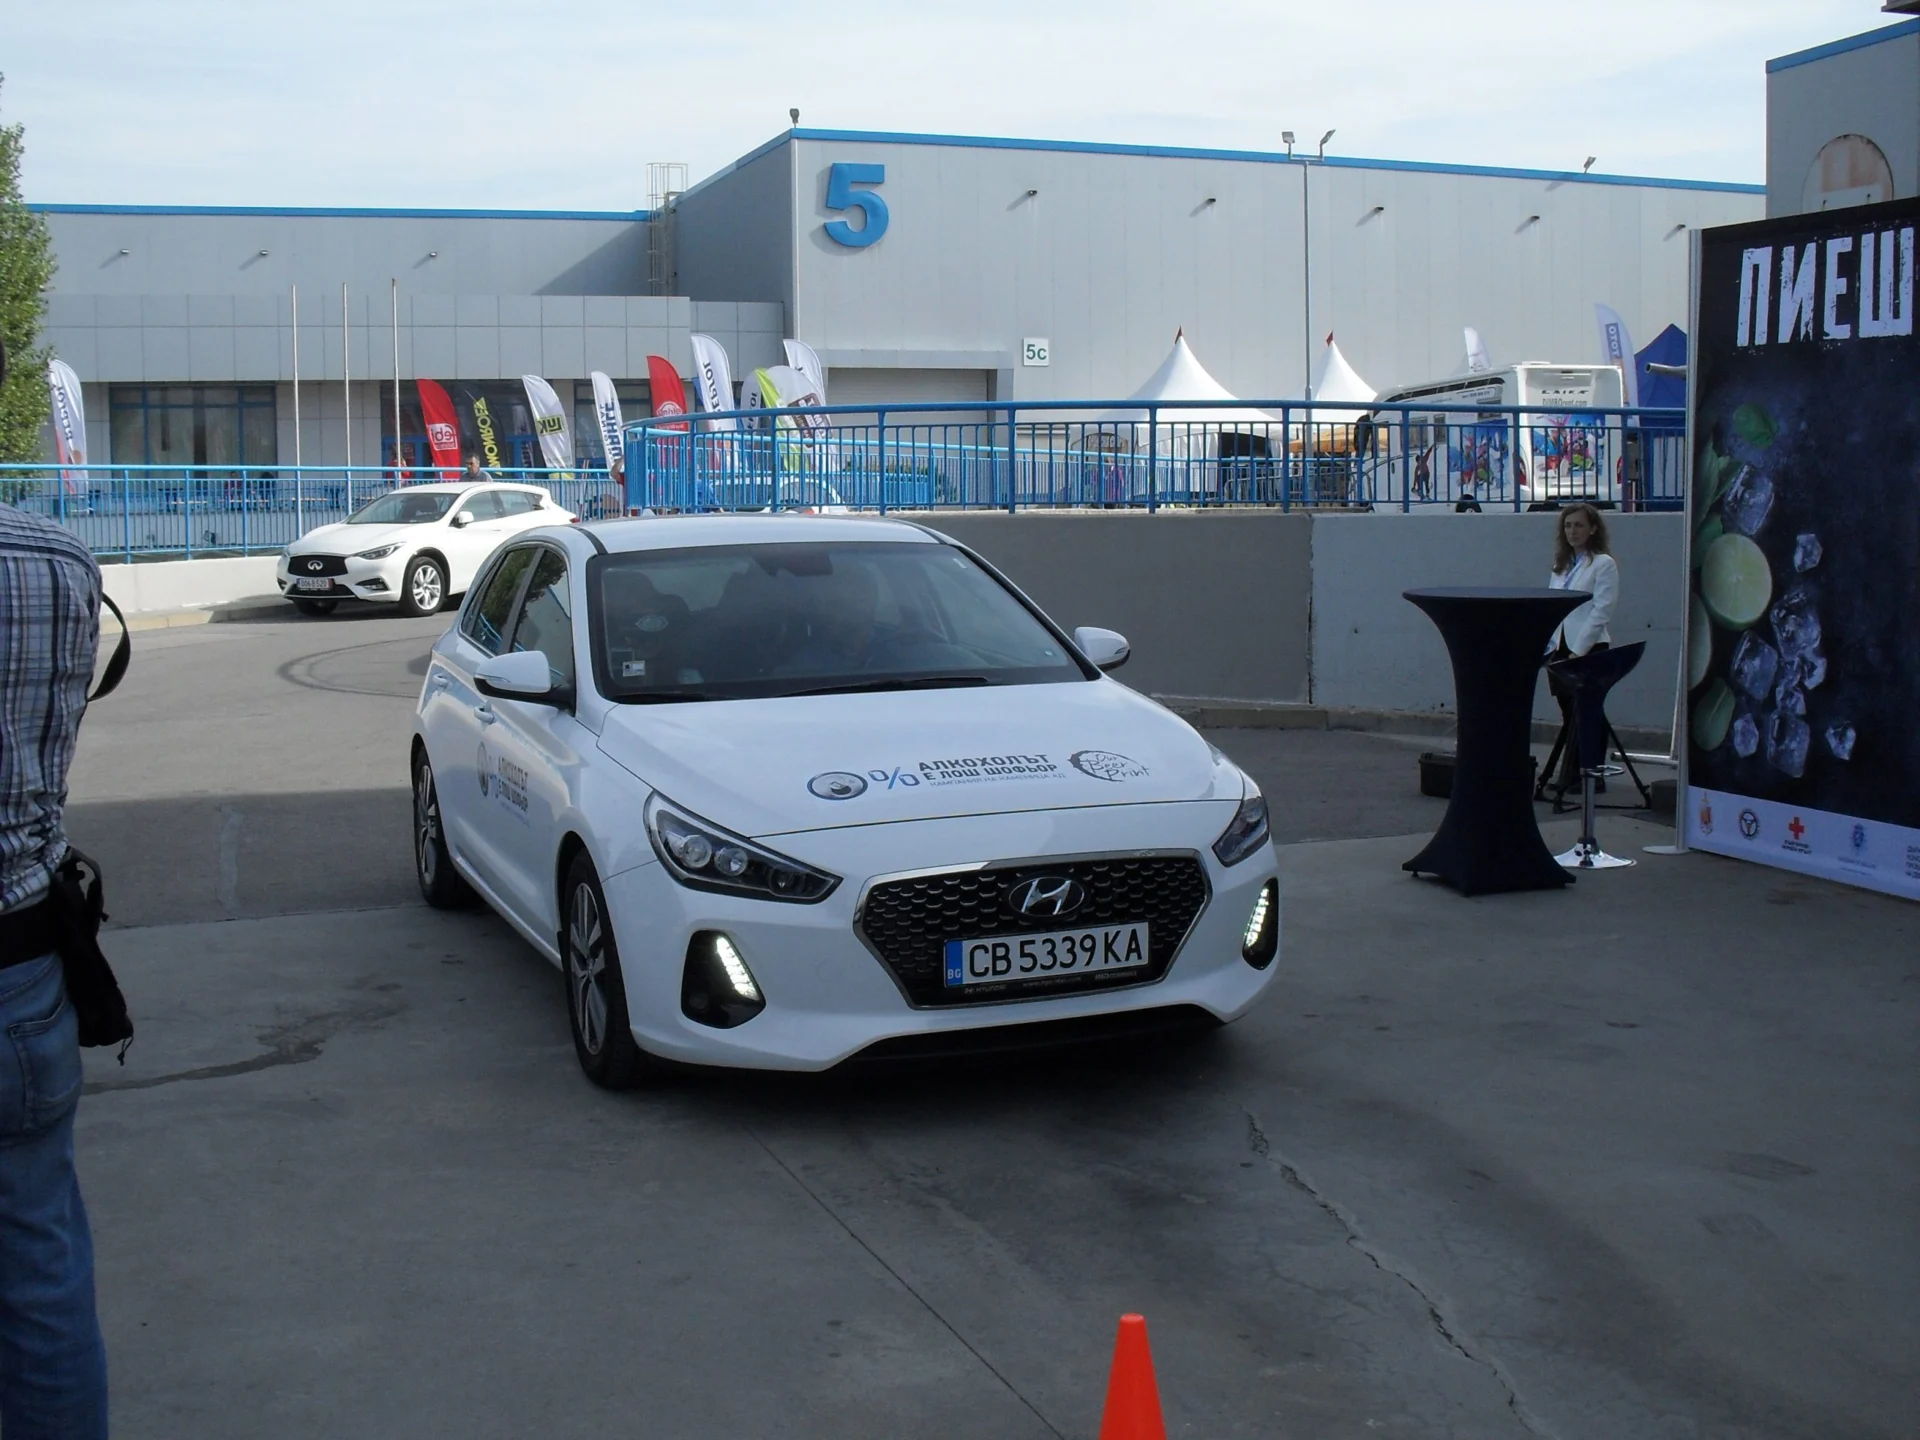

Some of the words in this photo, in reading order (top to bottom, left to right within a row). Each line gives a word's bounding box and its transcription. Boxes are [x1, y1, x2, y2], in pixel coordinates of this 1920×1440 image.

[823, 162, 889, 248] 5
[1736, 226, 1915, 347] ПИЕШ
[1025, 343, 1048, 360] 5c
[918, 754, 1050, 772] АЛКОХОЛЪТ
[939, 767, 982, 780] ЛОШ
[983, 763, 1058, 777] ШОФЬОР
[947, 968, 962, 979] BG
